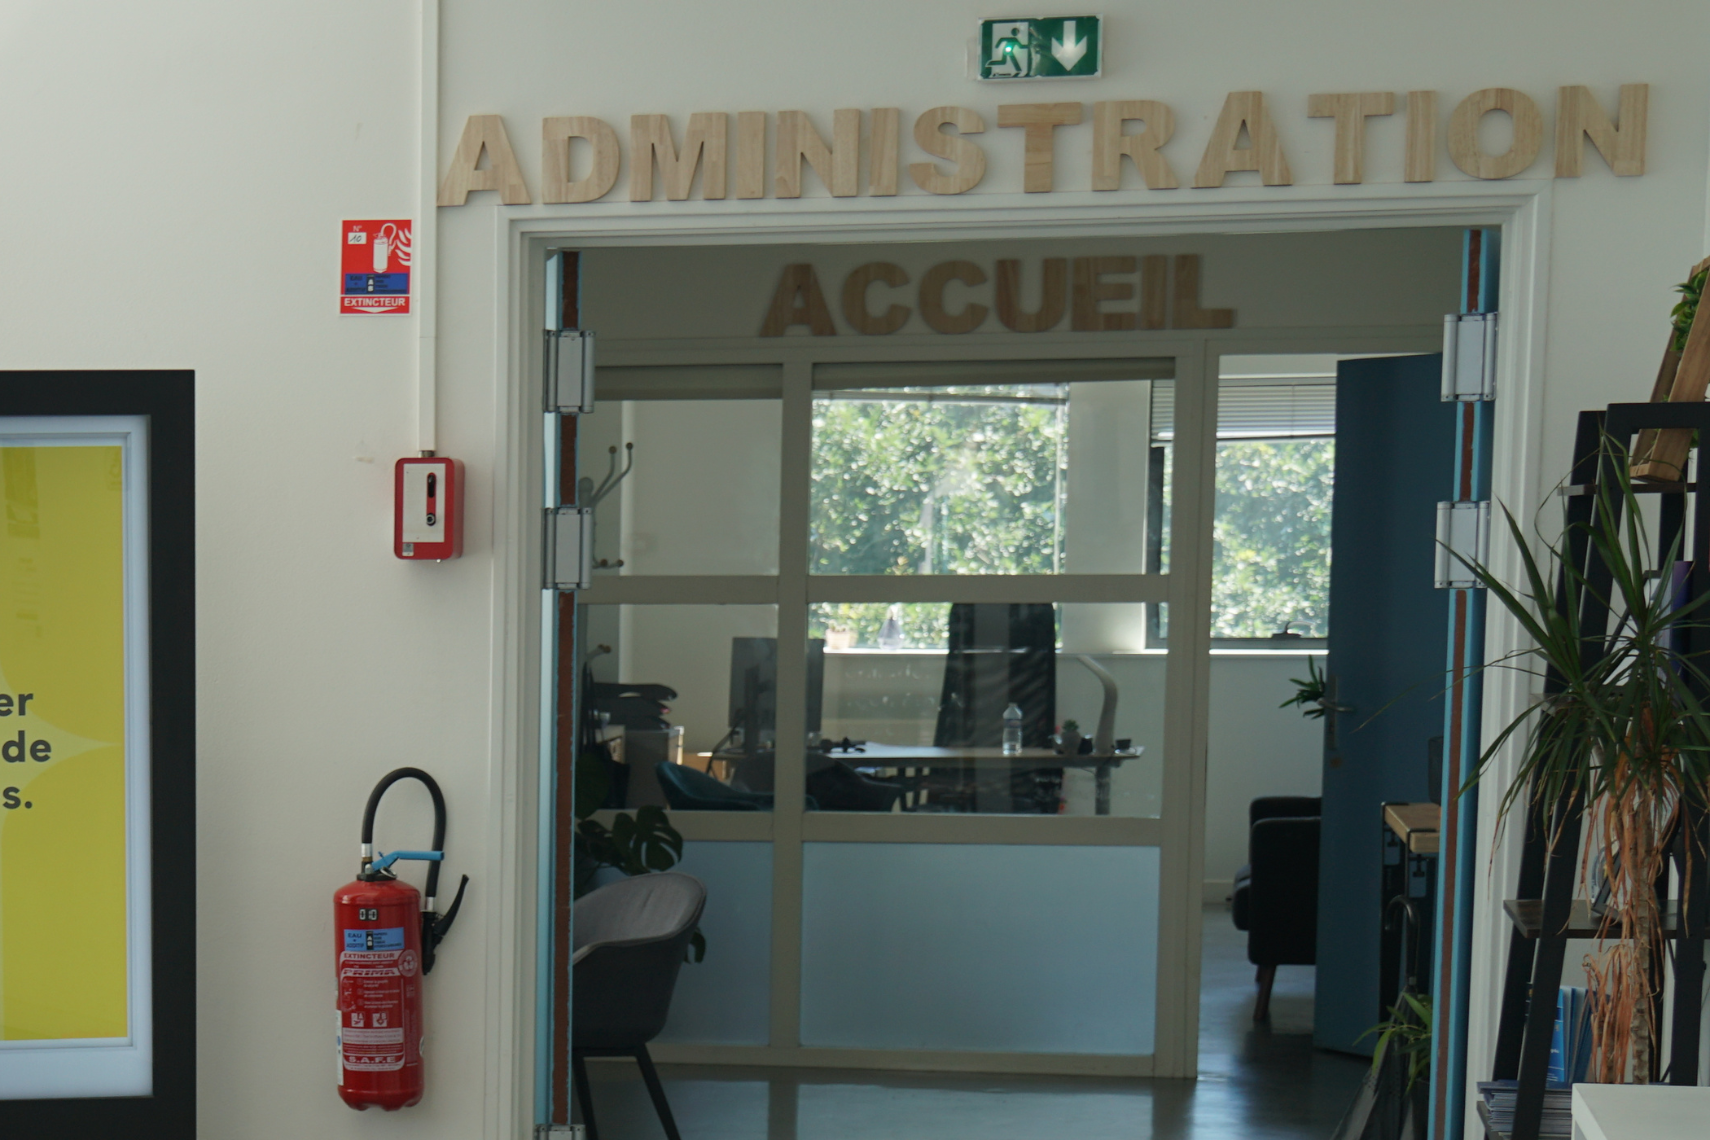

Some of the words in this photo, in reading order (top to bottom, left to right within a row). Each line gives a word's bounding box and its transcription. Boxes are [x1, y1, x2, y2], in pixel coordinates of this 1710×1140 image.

[436, 83, 1650, 207] ADMINISTRATION
[349, 235, 362, 243] 10
[344, 297, 406, 307] EXTINCTEUR
[759, 252, 1237, 338] ACCUEIL
[1, 730, 52, 763] de
[343, 952, 396, 960] EXTINCTEUR
